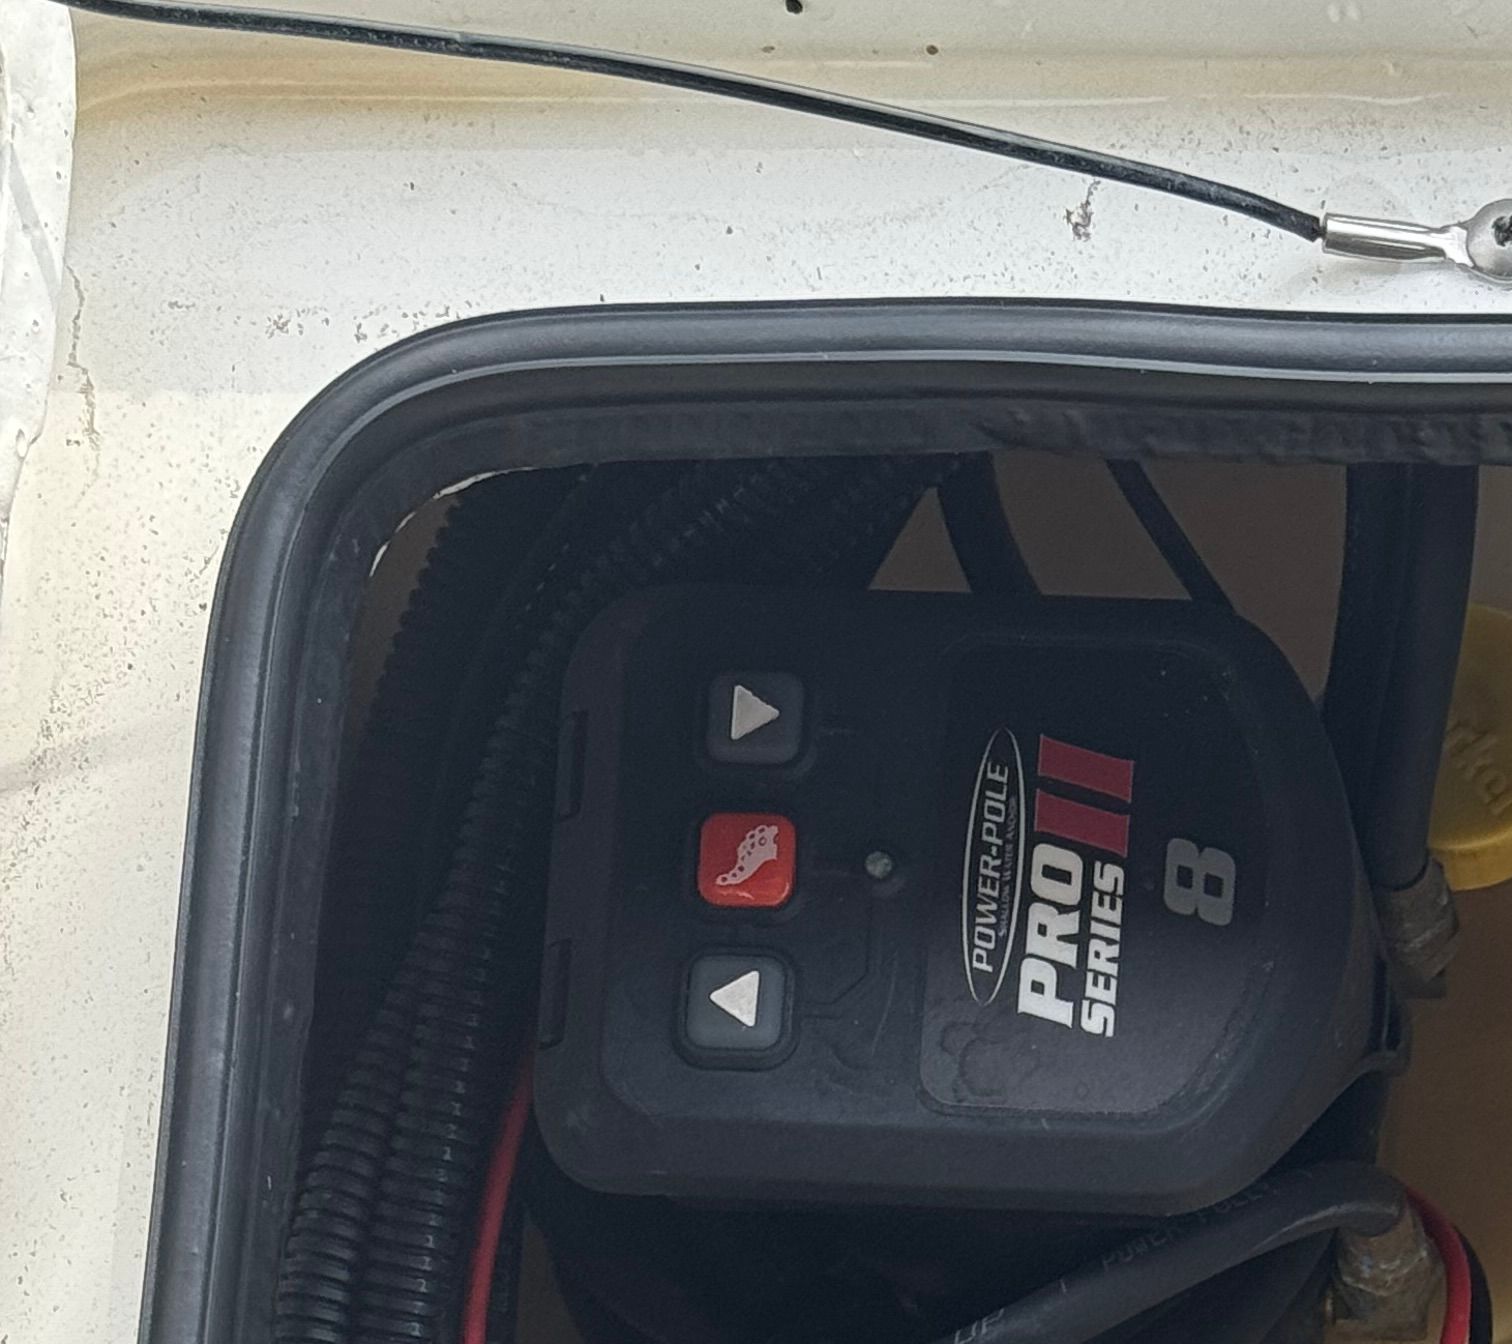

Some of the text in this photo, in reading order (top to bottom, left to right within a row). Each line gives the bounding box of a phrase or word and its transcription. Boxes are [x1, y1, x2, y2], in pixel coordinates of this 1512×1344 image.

[972, 762, 1009, 972] POWER-POLE
[1017, 844, 1084, 1028] PRO
[1080, 861, 1125, 1037] SERIES
[1163, 838, 1236, 926] 8
